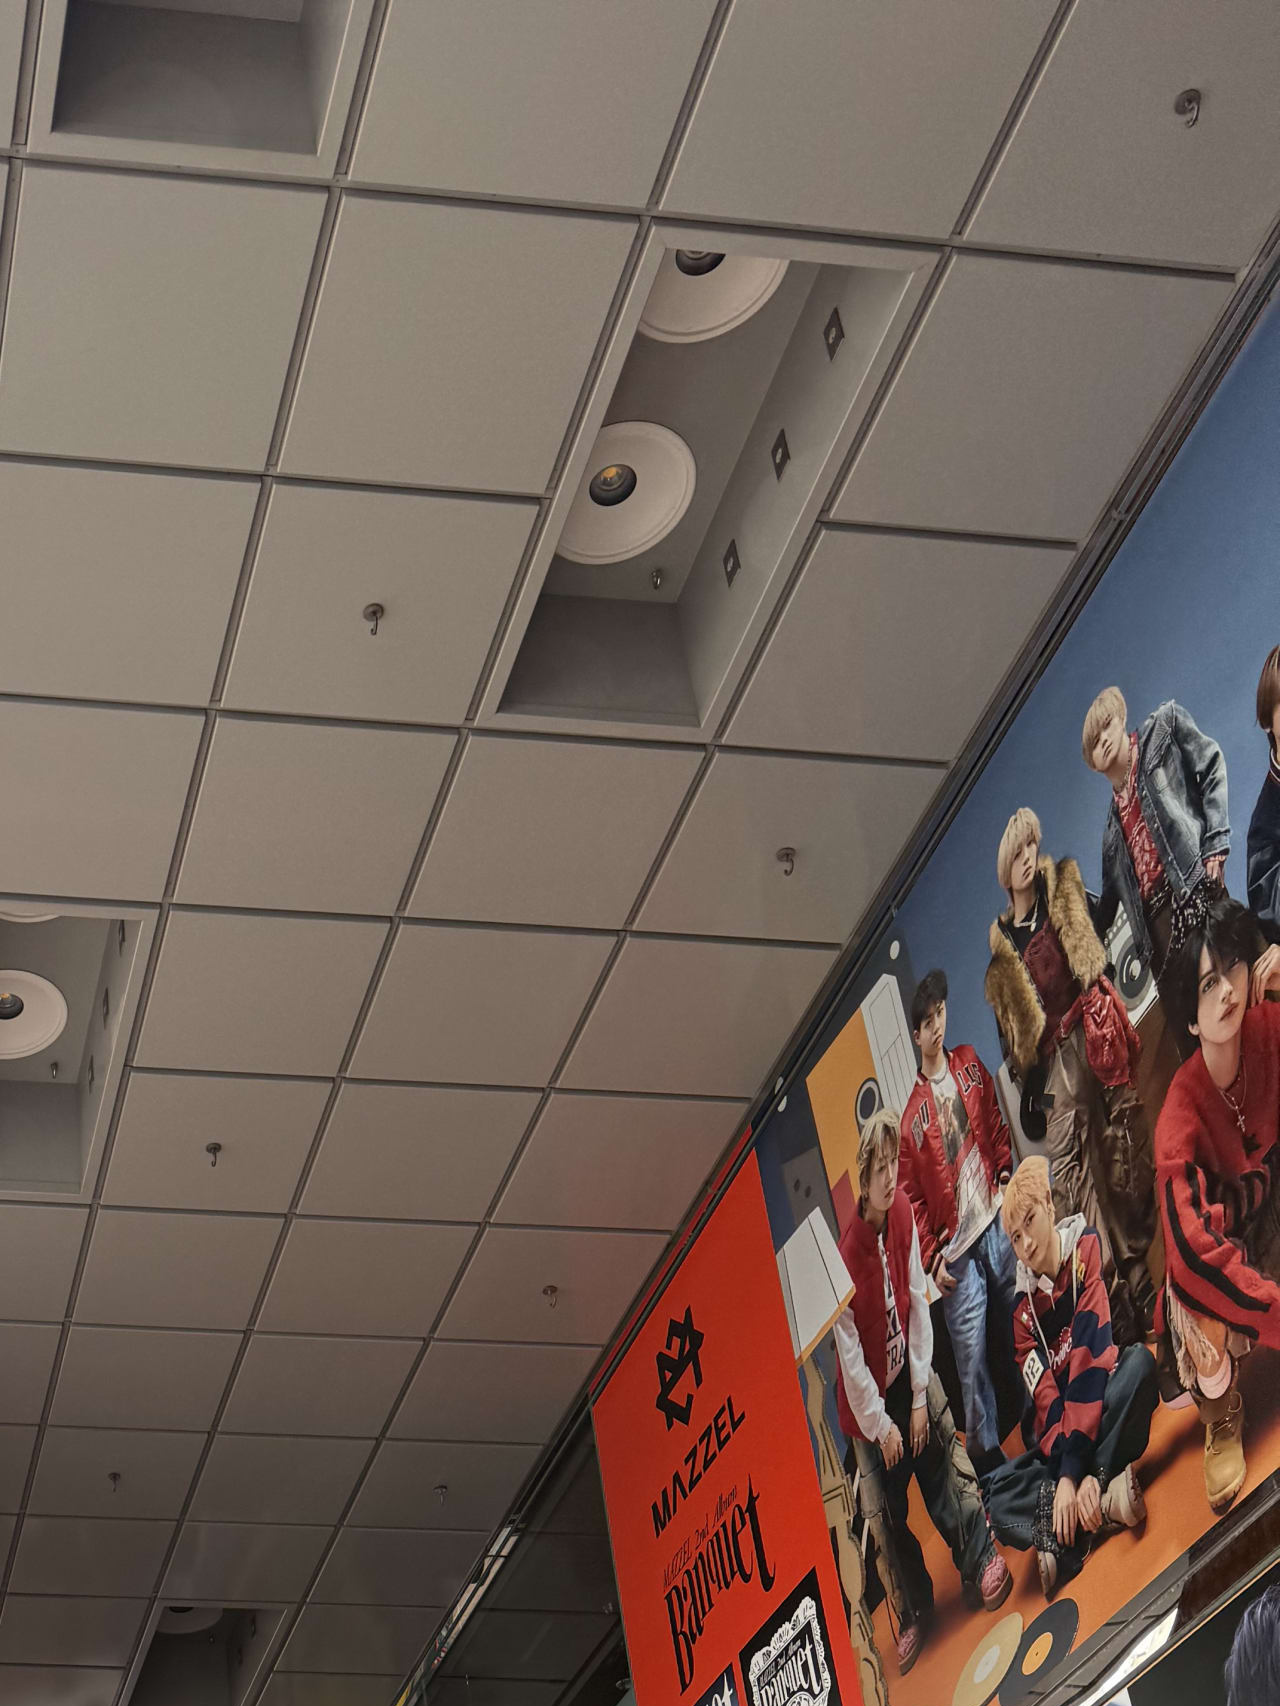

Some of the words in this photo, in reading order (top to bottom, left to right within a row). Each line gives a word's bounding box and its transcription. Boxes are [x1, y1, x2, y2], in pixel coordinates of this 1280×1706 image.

[651, 1395, 746, 1539] MAZZEL
[695, 1513, 709, 1550] 2nd
[712, 1485, 738, 1528] Album
[664, 1473, 776, 1696] Banquet
